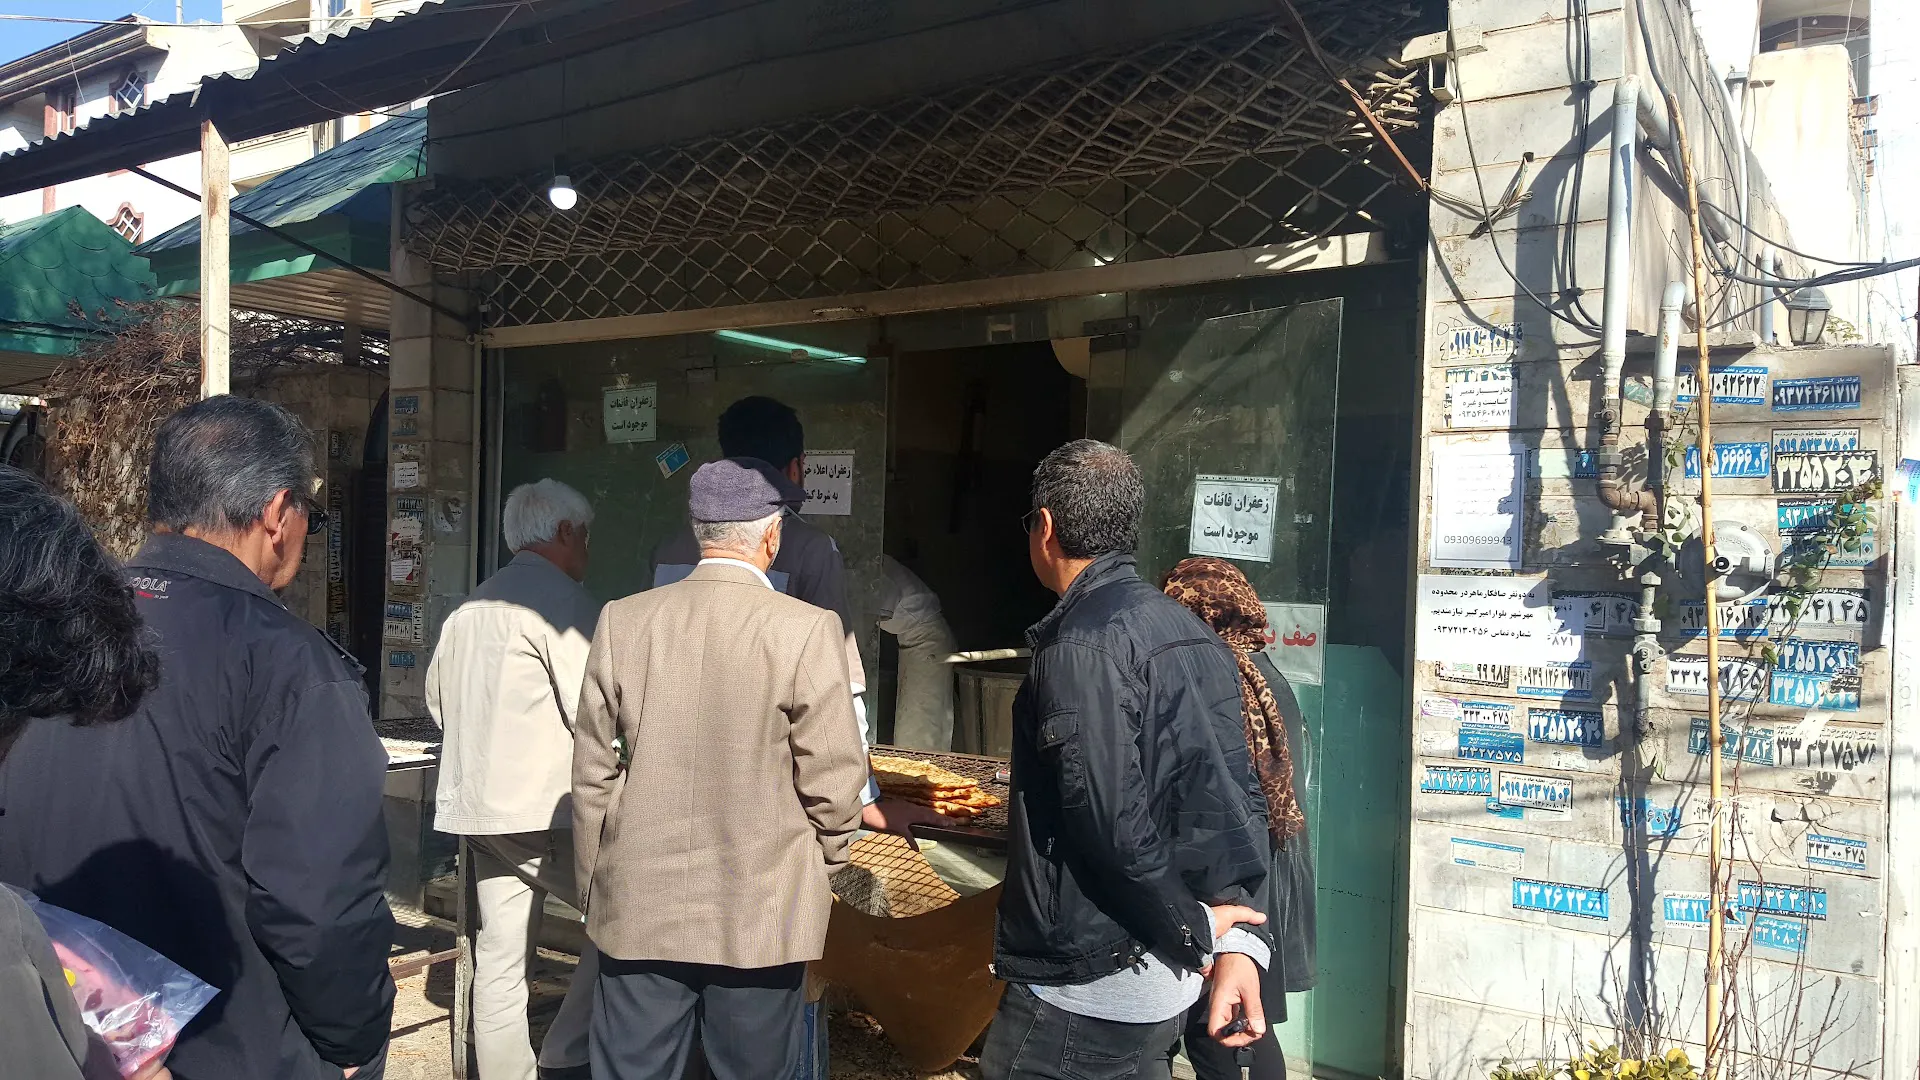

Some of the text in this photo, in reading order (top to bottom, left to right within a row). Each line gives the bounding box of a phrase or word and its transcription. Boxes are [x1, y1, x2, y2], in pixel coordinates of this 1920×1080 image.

[630, 396, 653, 409] زعفران
[612, 420, 648, 432] موجود است
[828, 464, 851, 478] زعفران
[816, 490, 831, 504] شرط
[832, 492, 838, 503] به
[1203, 492, 1270, 514] زعفران قائنات
[1203, 524, 1260, 544] موجود است
[1444, 536, 1512, 545] 09309699943
[1282, 624, 1317, 647] صف
